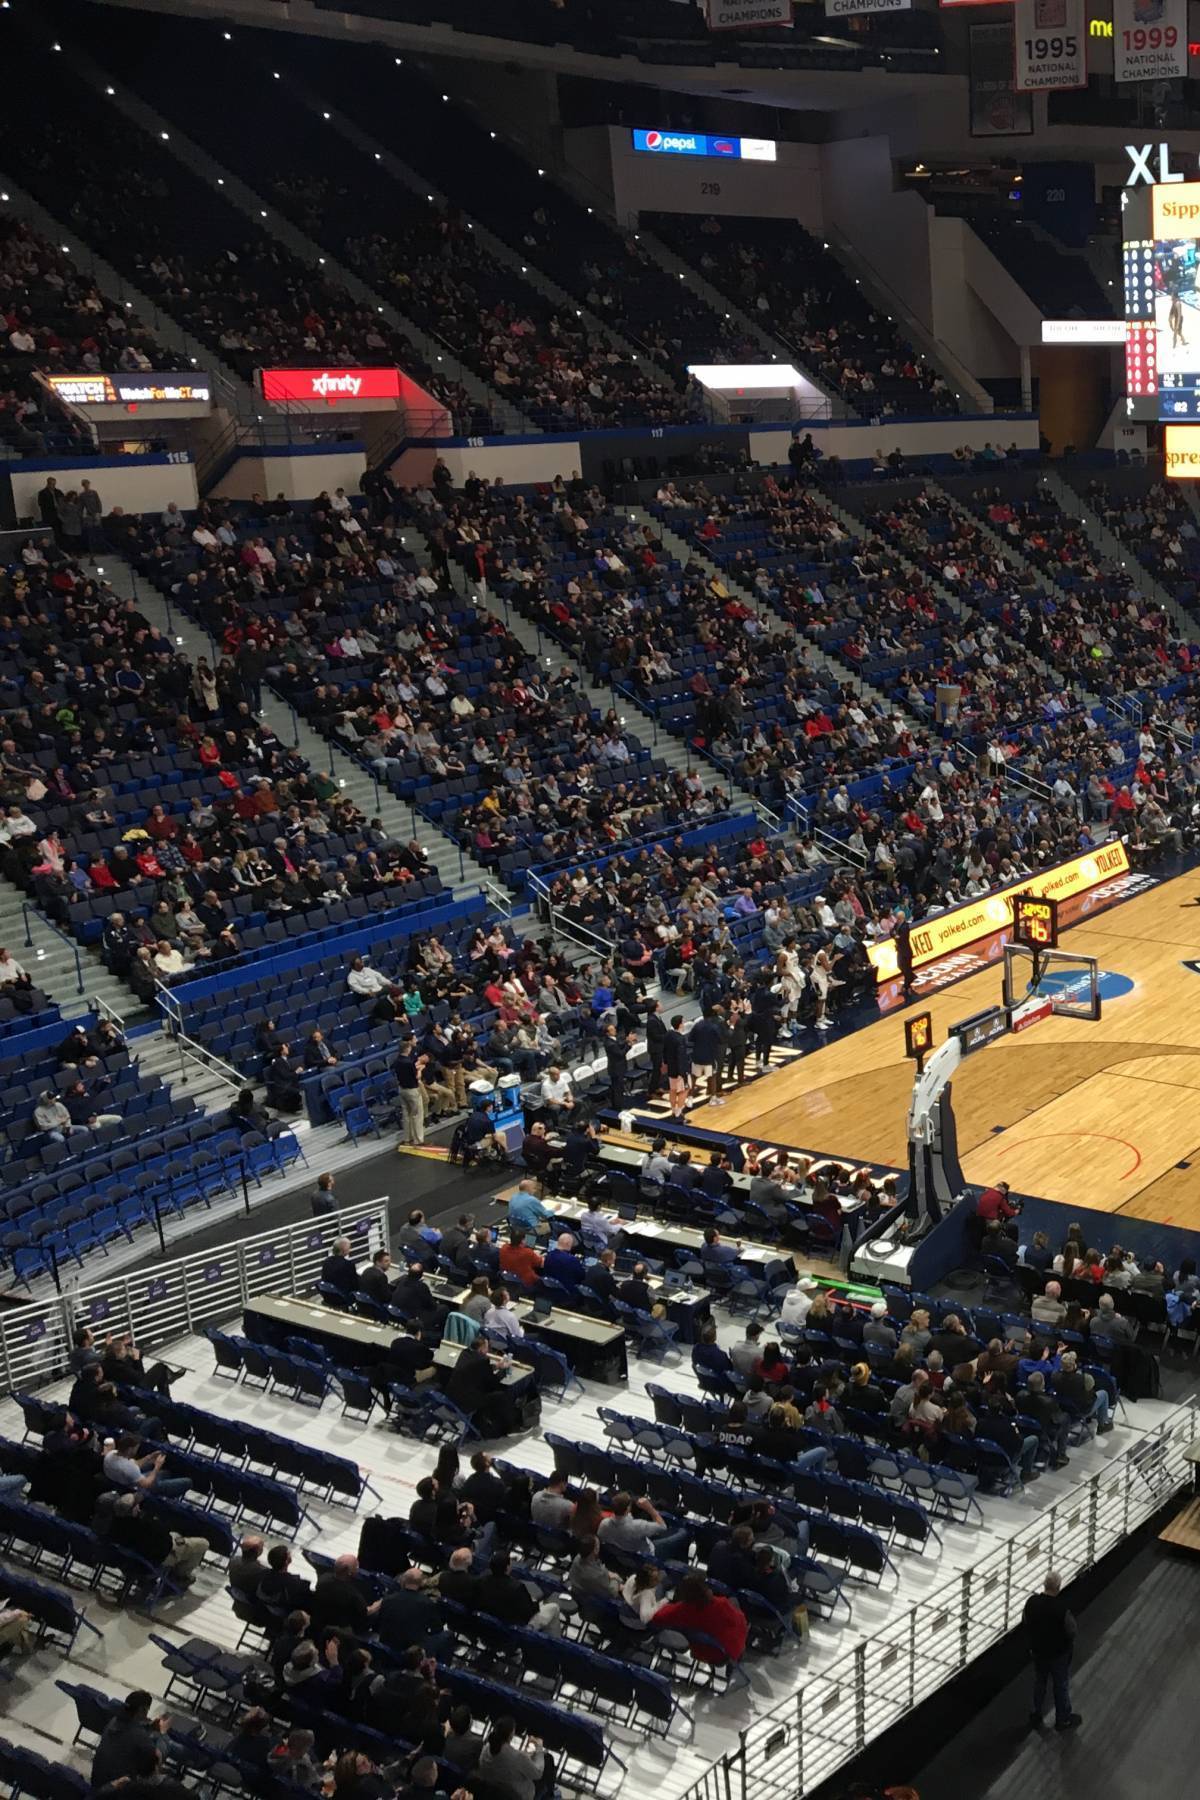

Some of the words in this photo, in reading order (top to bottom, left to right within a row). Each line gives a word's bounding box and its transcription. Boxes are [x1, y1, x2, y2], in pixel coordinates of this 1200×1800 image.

[833, 0, 901, 12] CHAMPIONS
[719, 7, 783, 24] CHAMPIONS
[1122, 25, 1178, 51] 1999
[1024, 36, 1078, 60] 1995
[1126, 53, 1176, 66] NATIONAL
[1028, 62, 1077, 74] NATIONAL
[1122, 65, 1180, 79] CHAMPIONS
[1024, 74, 1080, 87] CHAMPIONS
[663, 137, 697, 151] pepsi
[1124, 143, 1185, 186] XL
[701, 182, 720, 195] 219
[312, 373, 362, 396] xfinity
[119, 386, 210, 401] WatchForMeCT.org
[651, 428, 664, 439] 117
[467, 436, 484, 448] 116
[167, 451, 190, 464] 115
[1095, 848, 1123, 875] YOLKED
[1041, 872, 1080, 895] yolked.com
[1114, 878, 1161, 899] HEALTH
[938, 914, 985, 943] yolked.com
[931, 959, 989, 987] HEALTH
